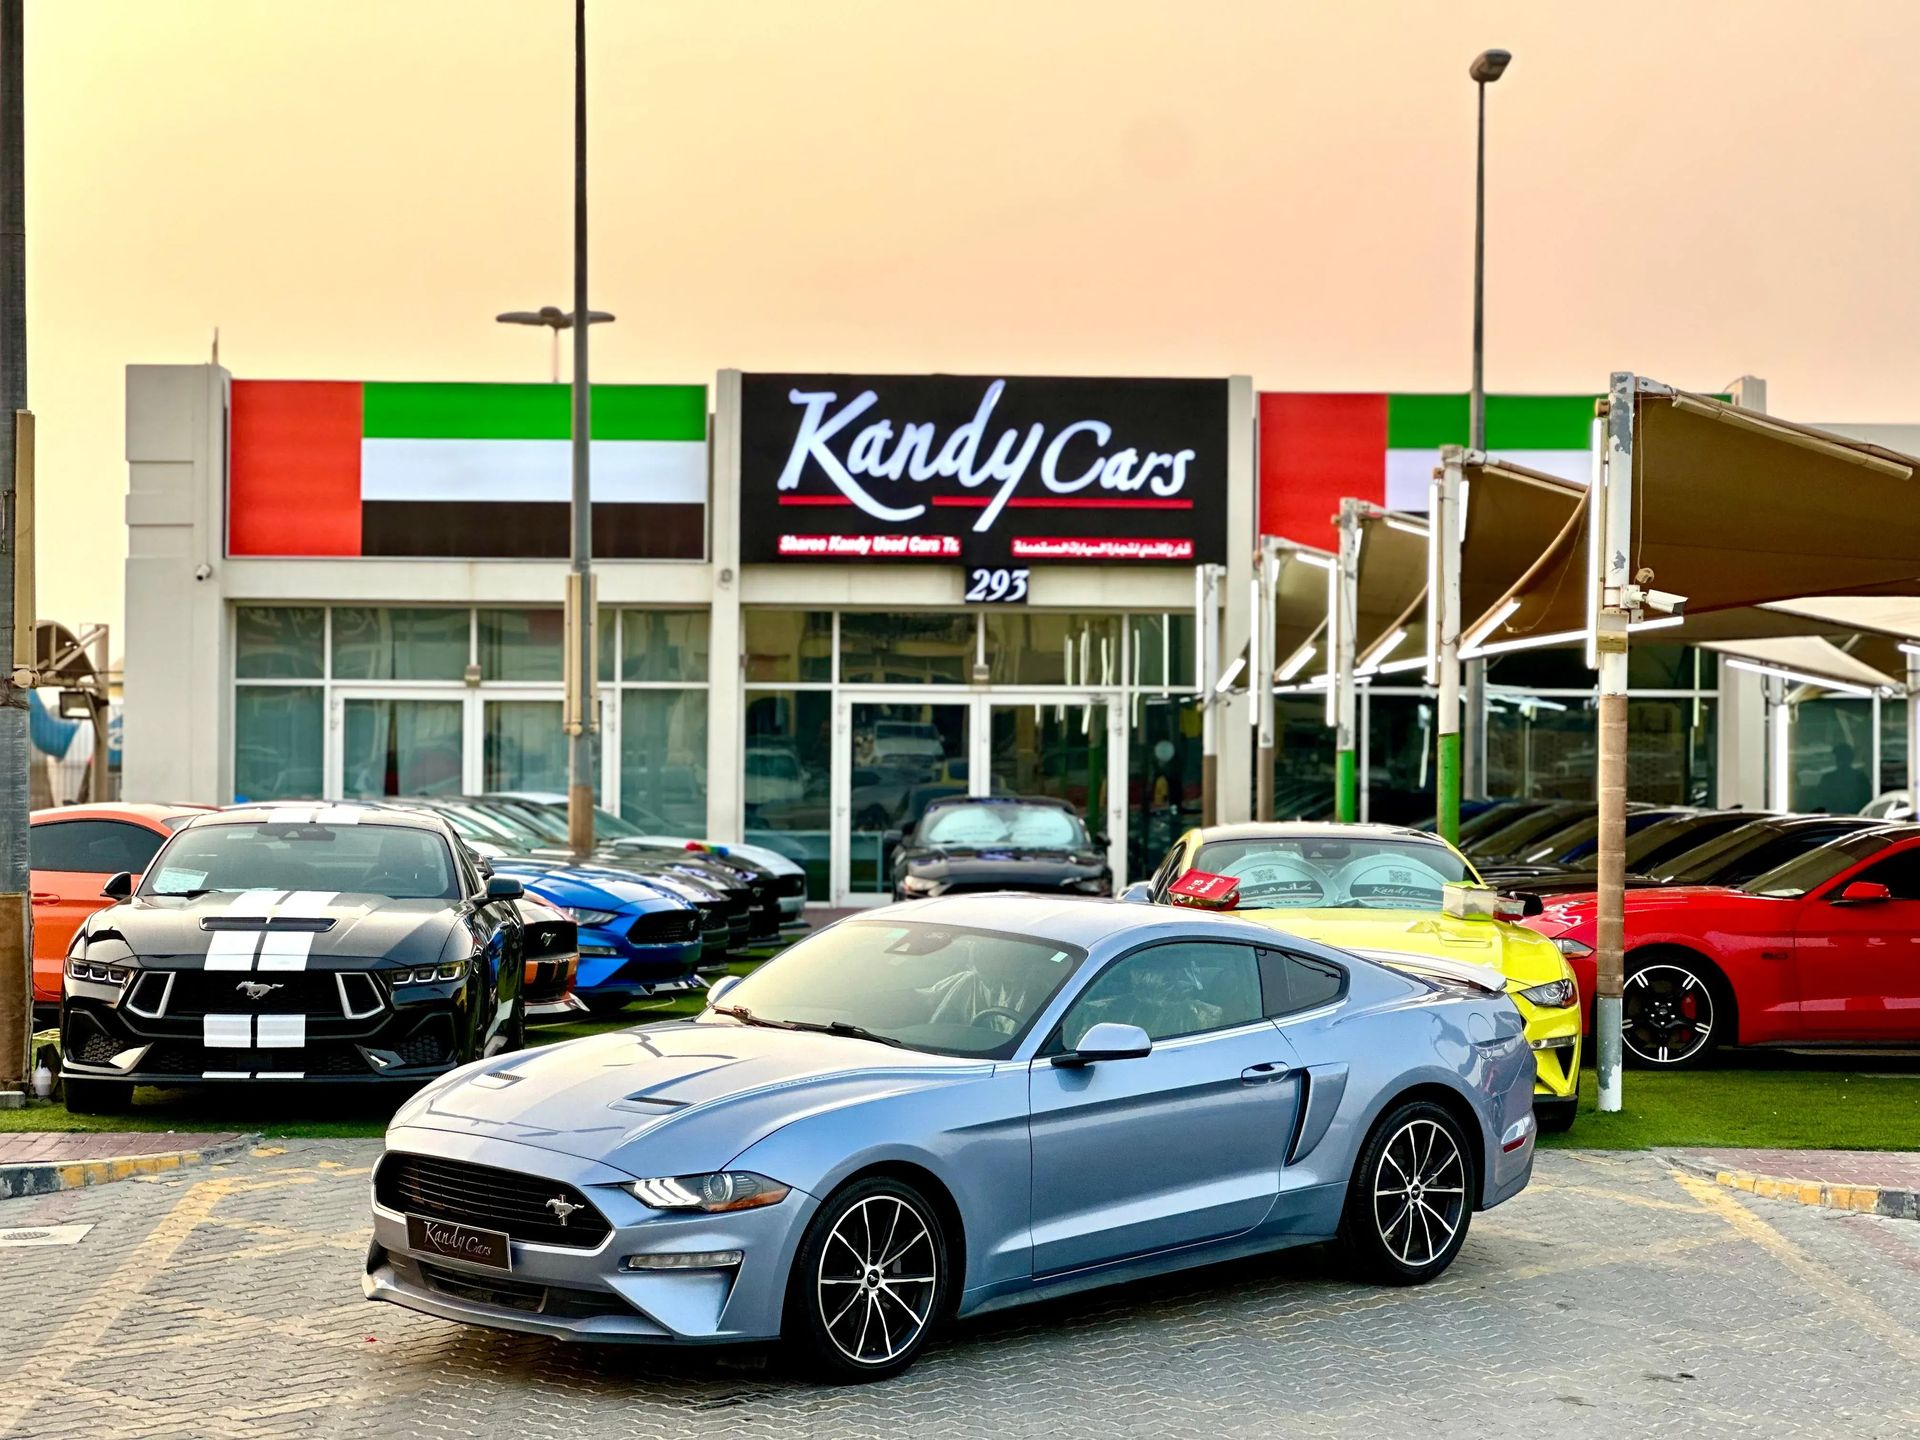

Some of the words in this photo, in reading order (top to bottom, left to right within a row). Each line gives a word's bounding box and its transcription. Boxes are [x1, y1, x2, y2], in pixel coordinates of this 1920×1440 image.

[777, 379, 1045, 532] Kandy
[1041, 420, 1195, 496] Cars
[828, 536, 871, 554] Kandy
[873, 536, 908, 551] Used
[909, 536, 940, 552] Cars
[966, 568, 1029, 602] 293
[1371, 886, 1408, 895] Kandy
[423, 1220, 465, 1258] Kandy
[465, 1236, 492, 1257] Cars
